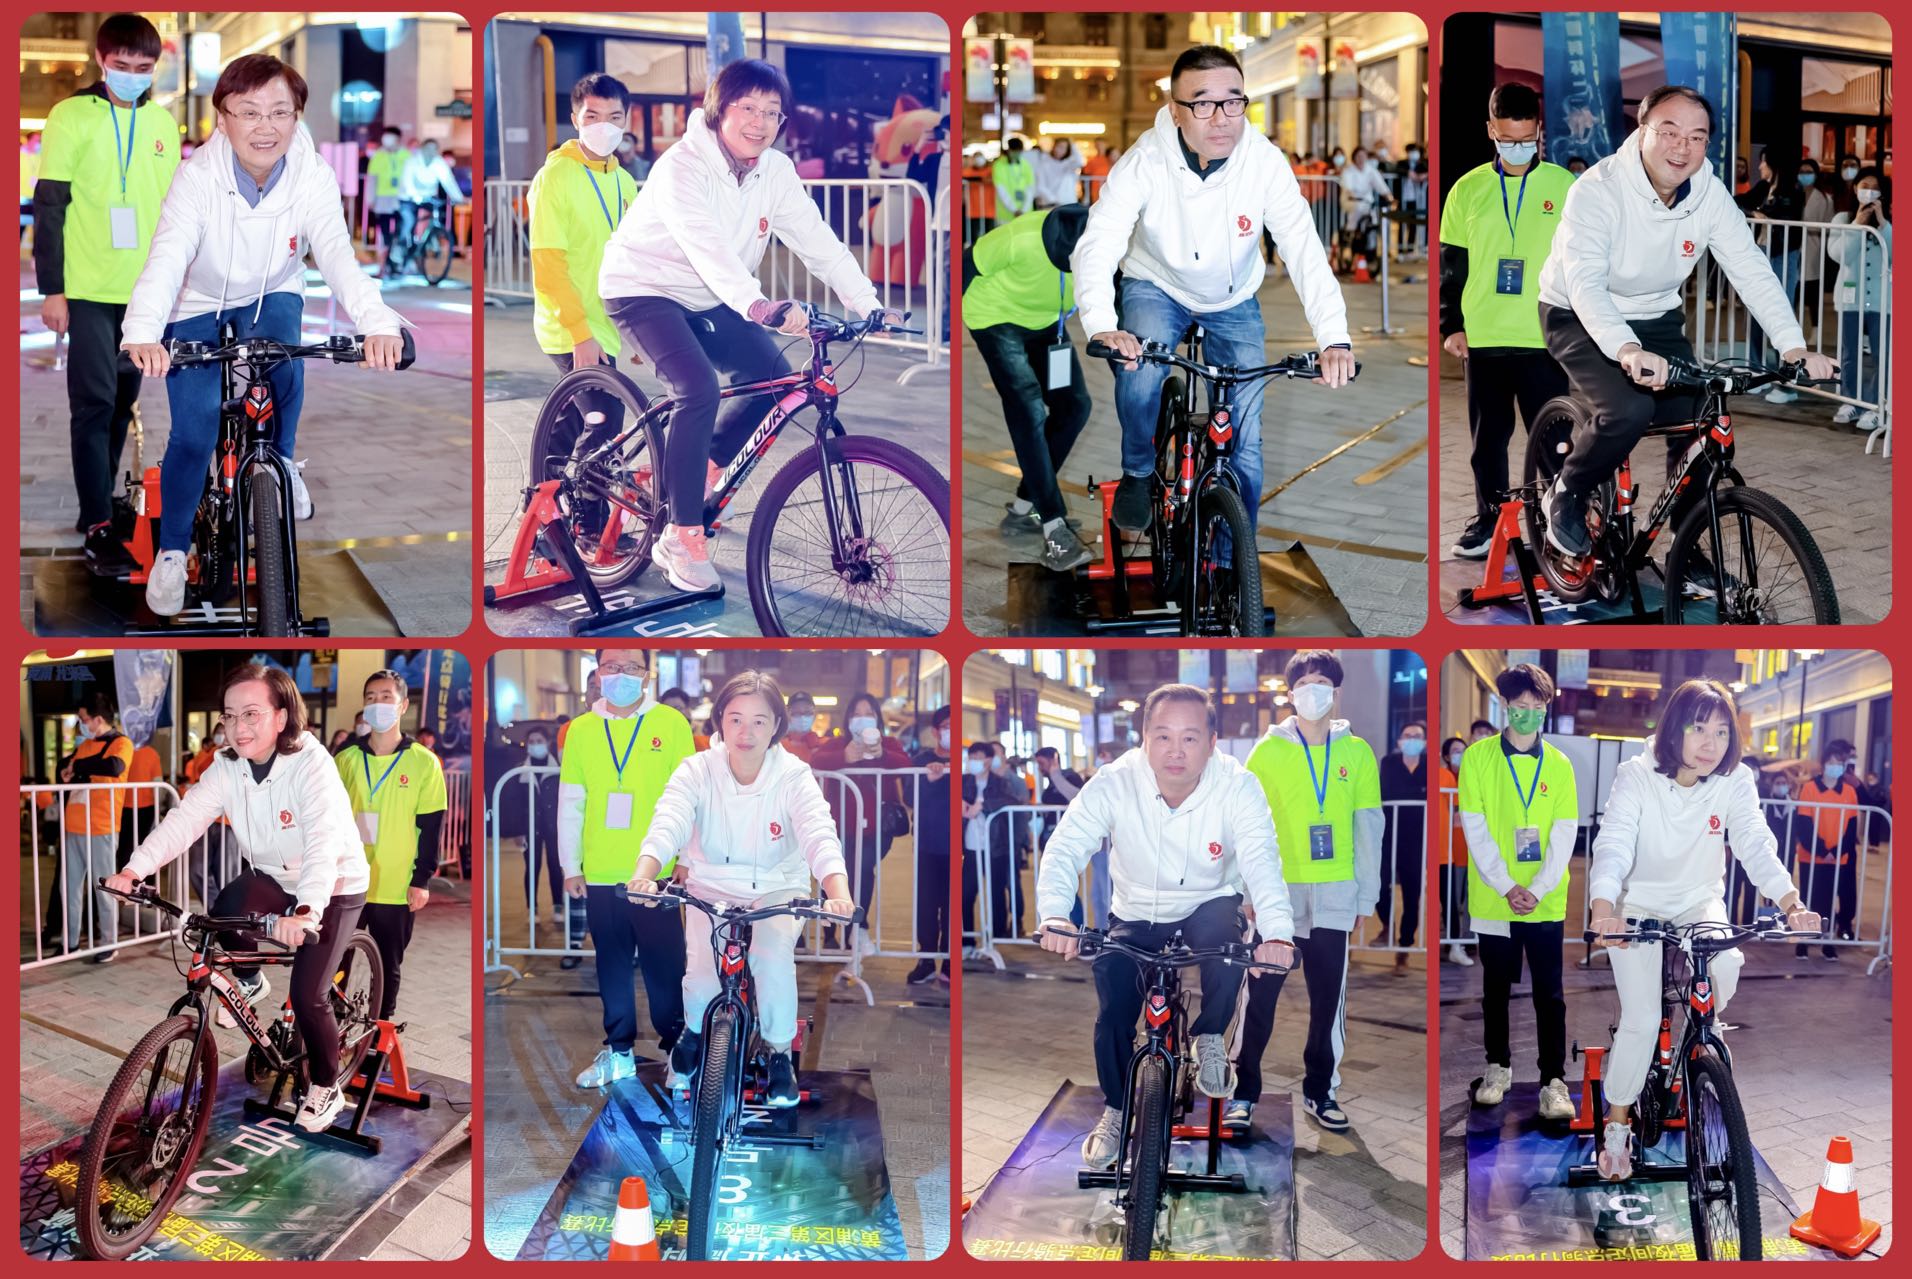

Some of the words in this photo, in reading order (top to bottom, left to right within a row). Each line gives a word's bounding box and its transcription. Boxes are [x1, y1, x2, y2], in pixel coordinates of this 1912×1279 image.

[724, 407, 782, 483] ICOLOUR
[1648, 451, 1689, 524] ICOLOUR
[226, 987, 265, 1040] ICOLOUR
[1608, 1194, 1657, 1226] 3
